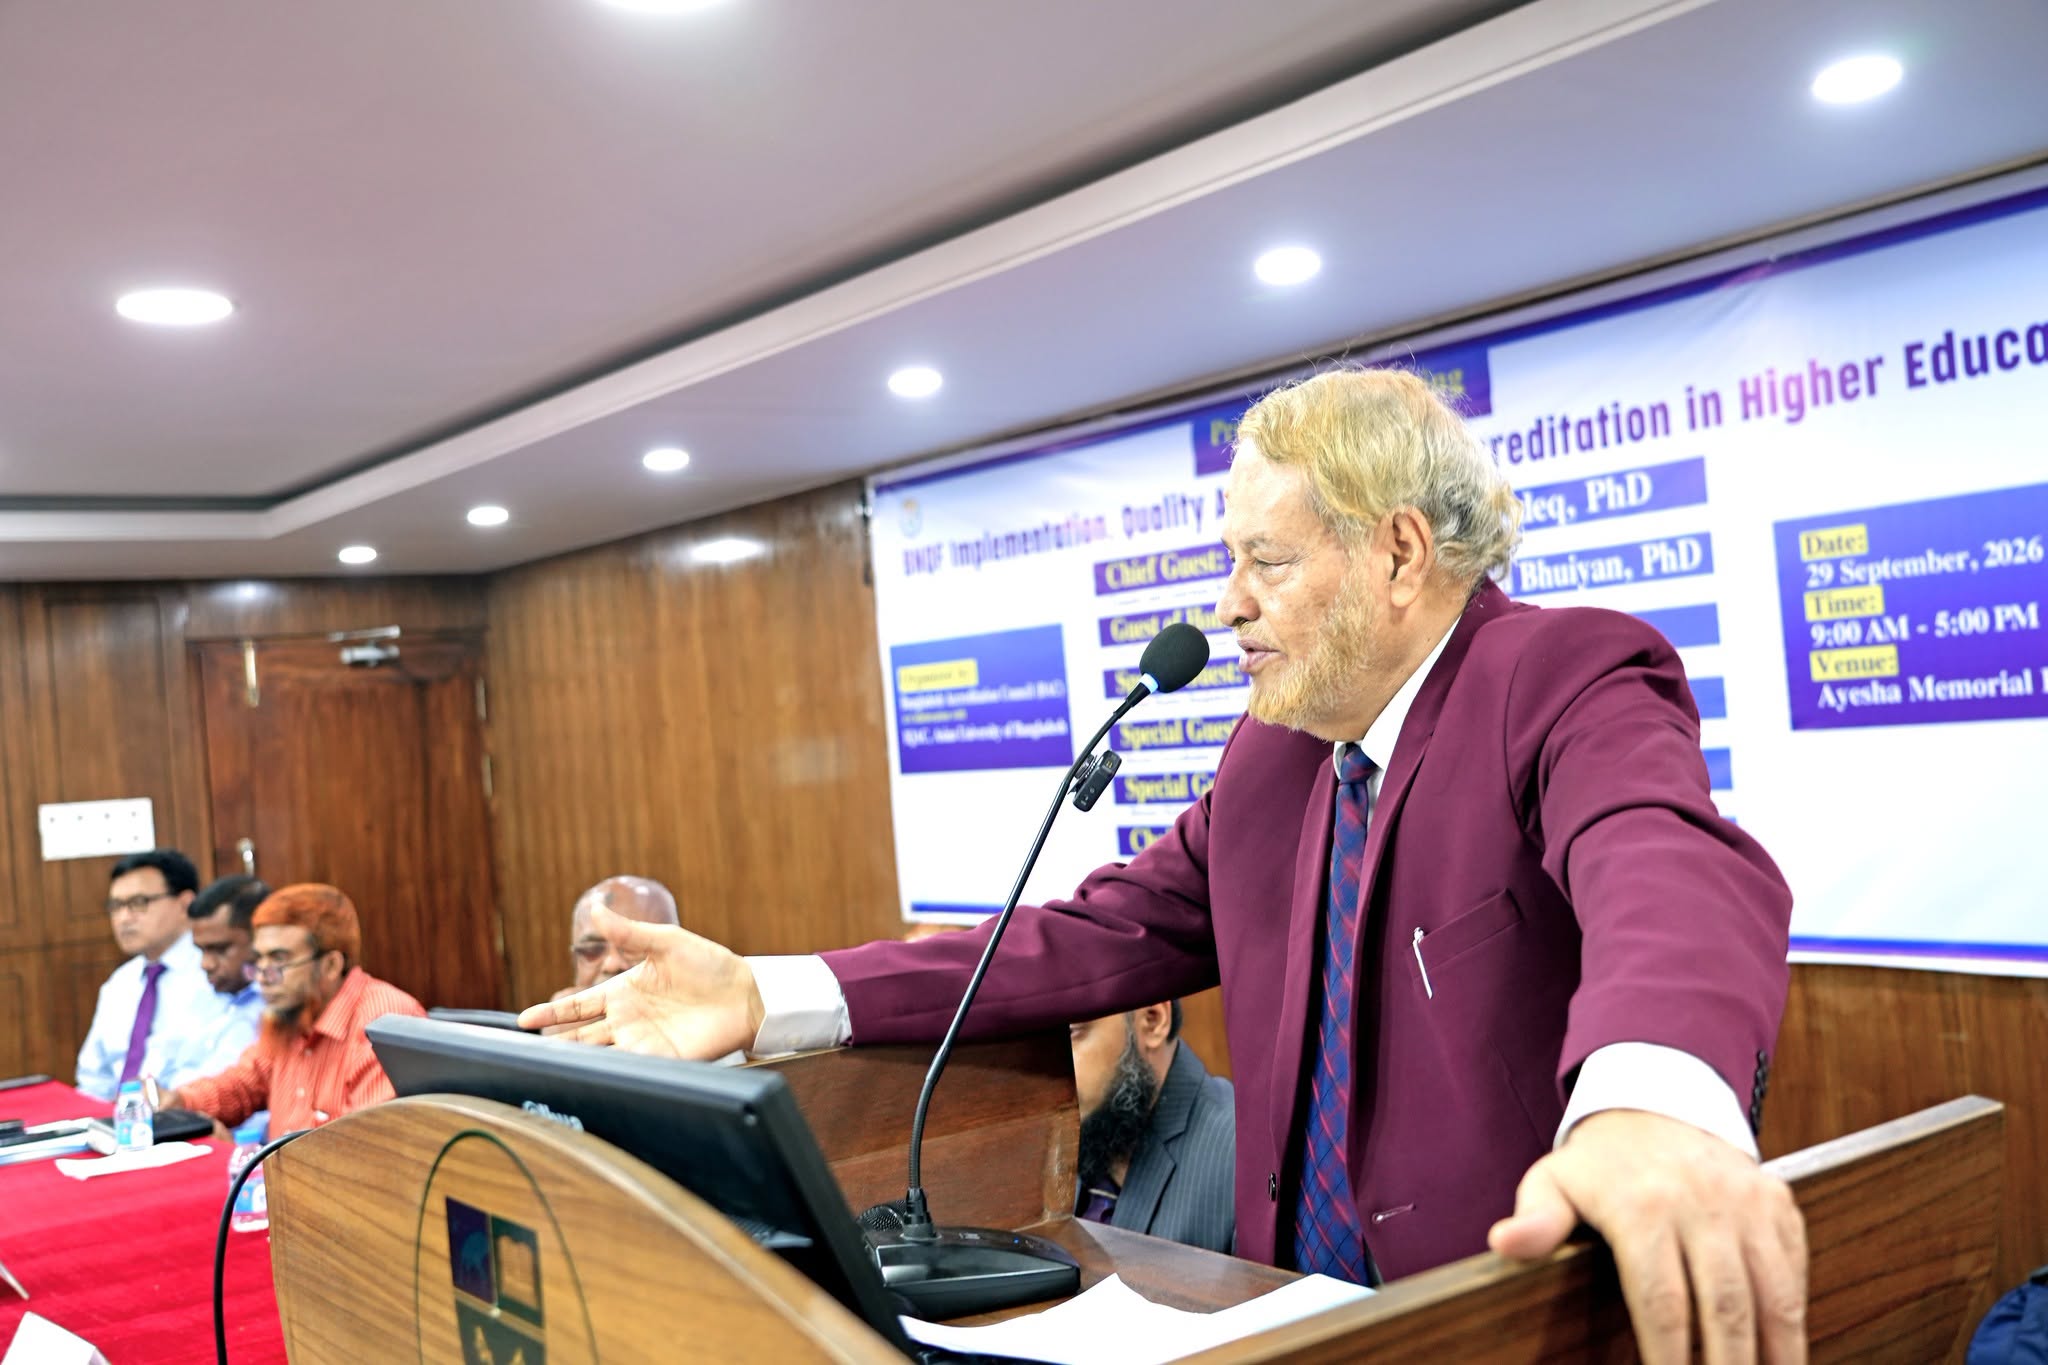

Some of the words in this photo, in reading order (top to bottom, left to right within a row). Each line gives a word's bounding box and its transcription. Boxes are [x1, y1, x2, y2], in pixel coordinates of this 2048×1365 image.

[1122, 493, 1204, 539] Quality
[1490, 401, 1670, 465] reditation
[1685, 385, 1722, 430] in
[1739, 356, 1884, 424] Higher
[1105, 555, 1157, 590] Chief
[1160, 548, 1226, 581] Guest:
[1585, 471, 1653, 514] PhD
[1805, 534, 1866, 556] Date:
[1806, 562, 1835, 588] 29
[1840, 548, 1979, 586] September,
[1983, 535, 2045, 569] 2026
[1110, 615, 1159, 642] Guest
[1518, 554, 1633, 593] Bhuiyan,
[1641, 537, 1702, 576] PhD
[1809, 590, 1876, 617] Time:
[1810, 620, 1862, 648] 9:00
[1865, 614, 1910, 643] AM
[1934, 607, 1990, 638] 5:00
[1993, 601, 2041, 631] PM
[1815, 653, 1897, 675] Venue:
[1818, 679, 1903, 712] Ayesha
[1908, 668, 2034, 702] Memorial
[1119, 720, 1184, 750] Special
